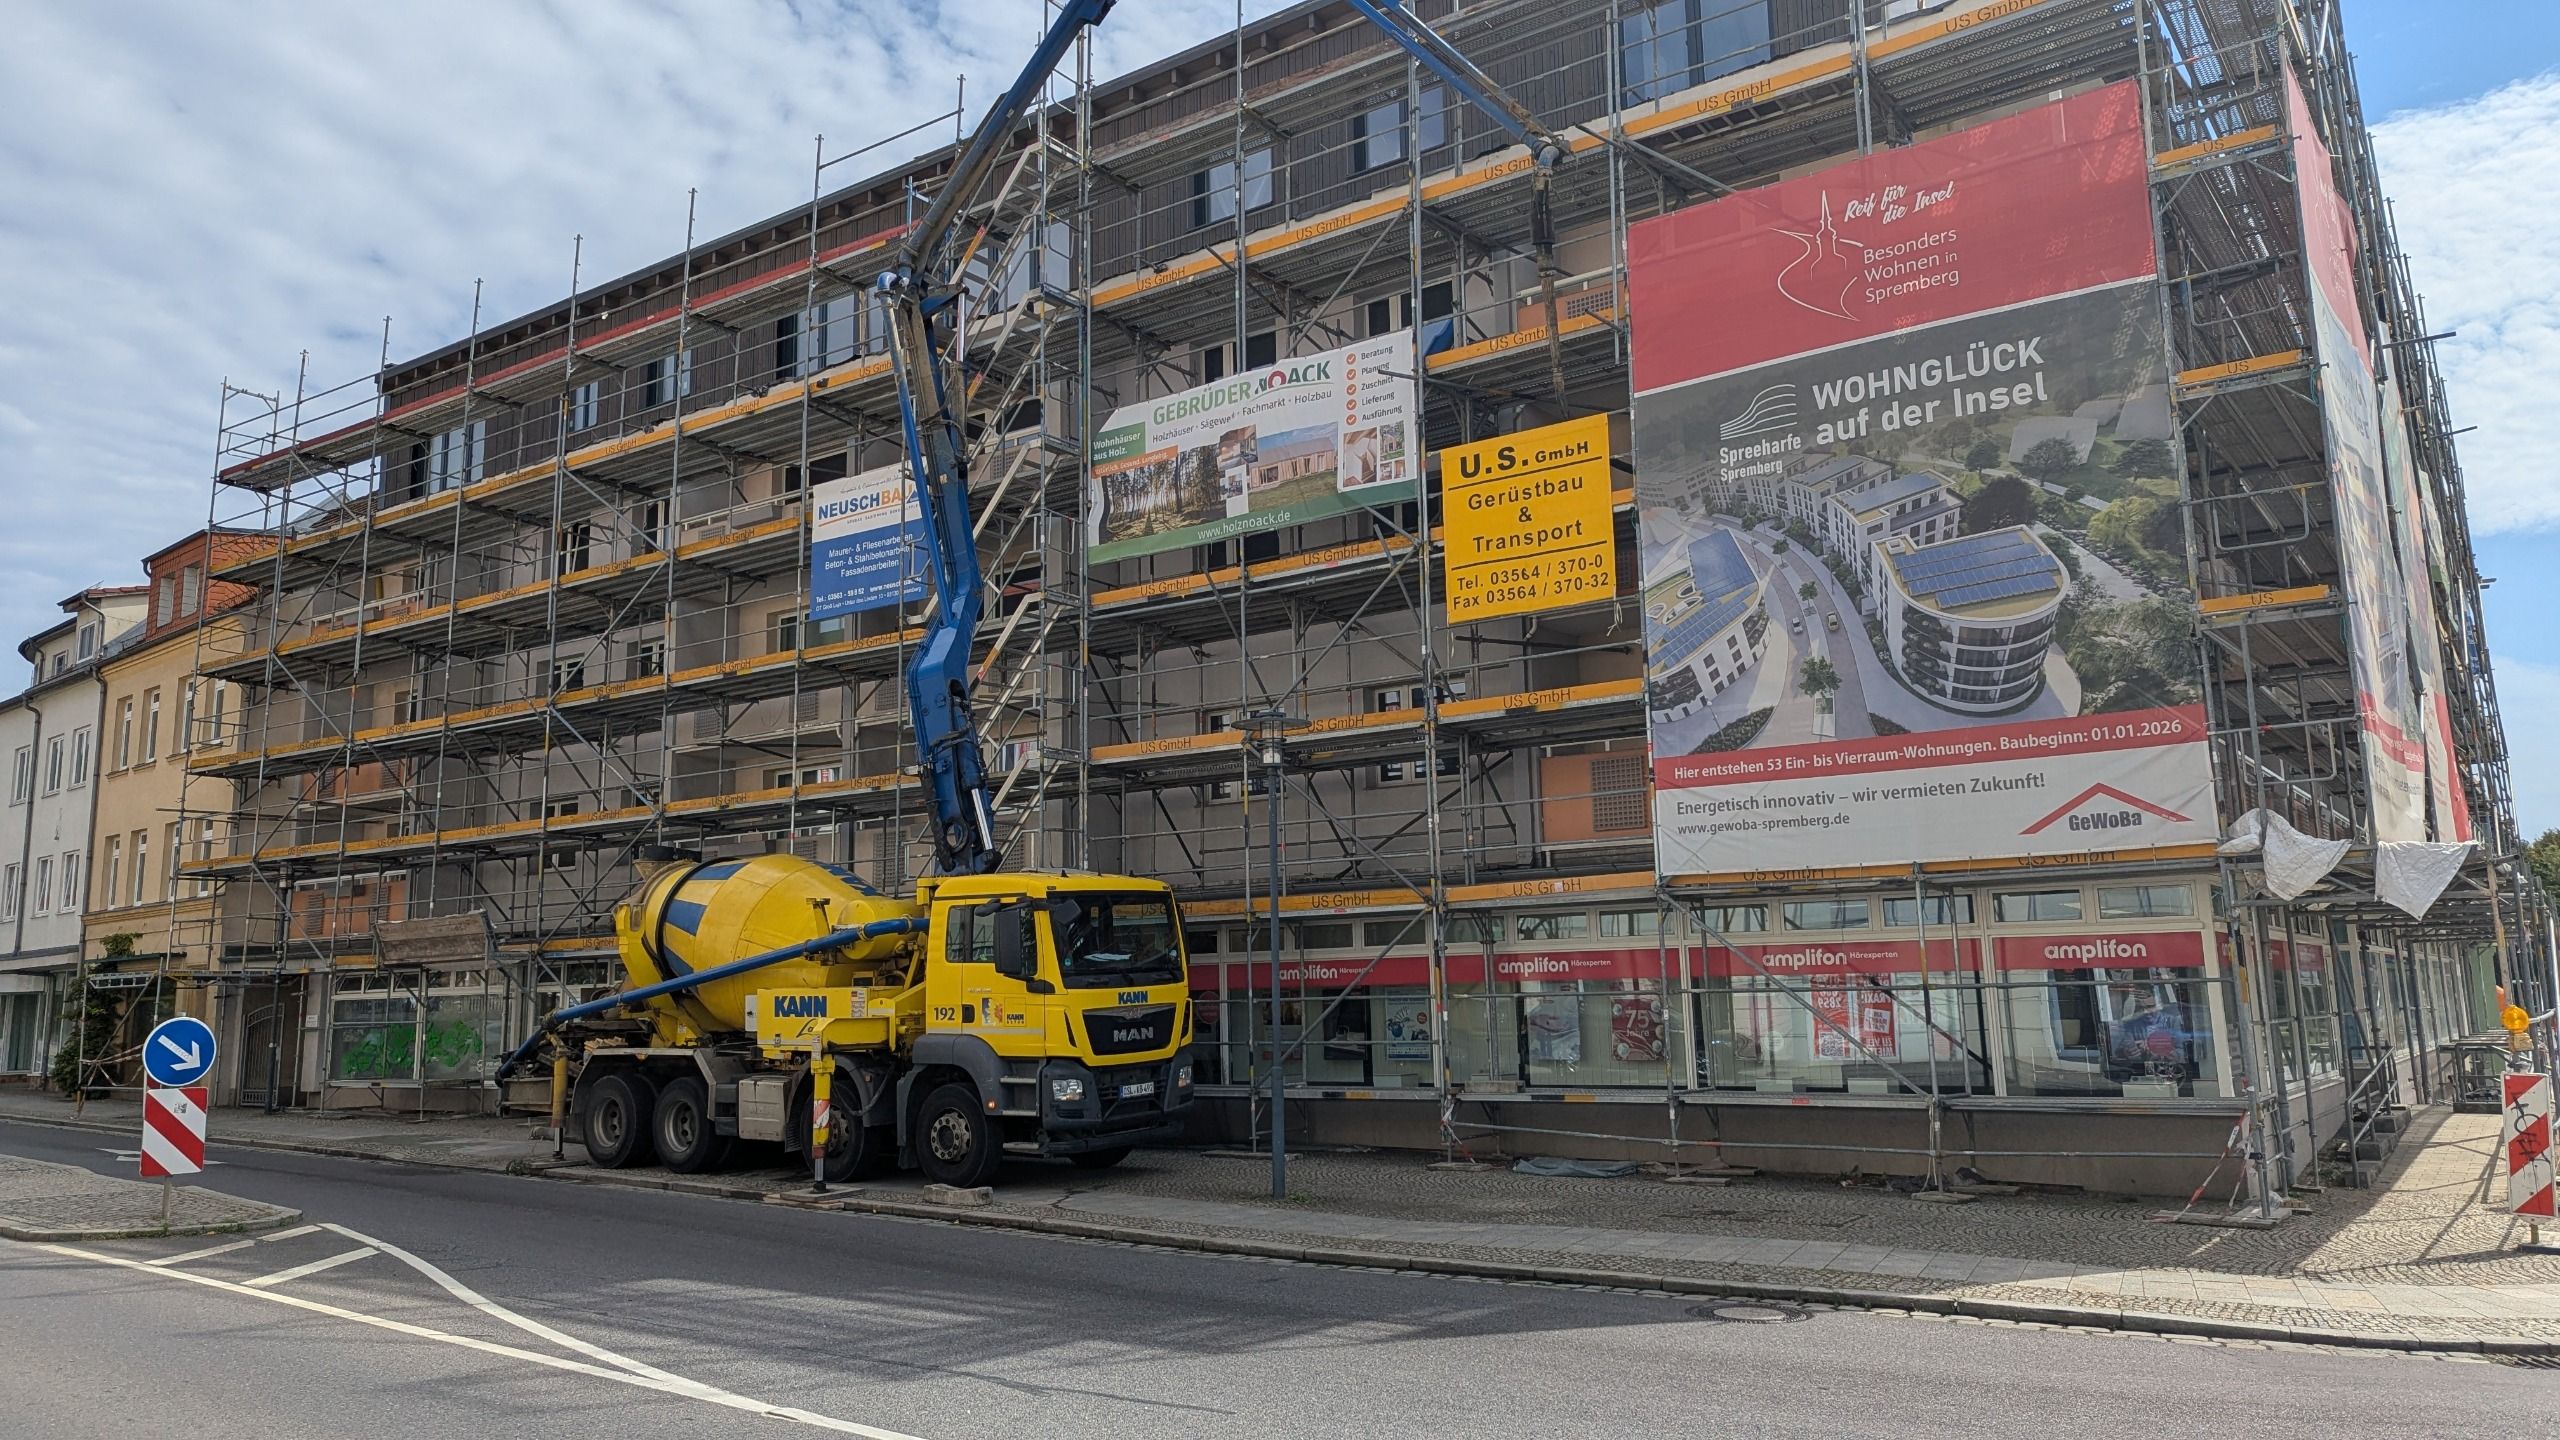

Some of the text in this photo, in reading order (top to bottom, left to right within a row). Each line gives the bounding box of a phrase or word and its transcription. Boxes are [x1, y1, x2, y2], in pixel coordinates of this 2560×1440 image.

[1945, 14, 1970, 32] US
[1696, 78, 1771, 113] US GmbH
[2203, 139, 2224, 153] US
[1484, 164, 1503, 180] US
[1844, 185, 1907, 222] Reif für
[1883, 181, 1954, 224] die Insel
[1296, 213, 1352, 240] US GmbH
[1864, 229, 1957, 264] Besonders
[1864, 252, 1958, 283] Wohnen in
[1136, 266, 1185, 290] US GmbH
[1865, 270, 1959, 304] Spremberg
[1489, 333, 1508, 351] US
[1361, 345, 1393, 360] Beratung
[872, 360, 892, 374] Gmb
[1361, 361, 1390, 375] Planung
[1812, 336, 2045, 410] WOHNGLÜCK
[2227, 360, 2249, 373] US
[1361, 376, 1394, 391] Zuschnitt
[1153, 381, 1252, 425] GEBRÜDER
[1361, 391, 1395, 406] Lieferung
[1816, 371, 2048, 445] auf der Insel
[724, 401, 759, 417] US GmbH
[1152, 390, 1332, 444] Holzhäuser Fachmarkt Holzbau
[1362, 405, 1402, 422] Ausführung
[1093, 431, 1142, 449] Wohnhäuser
[1719, 432, 1801, 464] Spreeharfe
[1093, 447, 1128, 461] aus Holz.
[1460, 441, 1589, 479] U.S. GmbH
[1720, 460, 1783, 483] Spremberg
[1468, 476, 1583, 510] Gerüstbau
[1518, 506, 1533, 523] &
[1197, 510, 1291, 540] www.holznoack.de
[720, 528, 754, 545] US GmbH
[1473, 520, 1583, 553] Transport
[828, 547, 854, 558] Maurer-
[855, 544, 861, 552] &
[1303, 545, 1360, 566] US GmbH
[825, 556, 853, 570] Beton- &
[840, 559, 899, 577] Fassadenarbeiten
[1457, 575, 1484, 591] Tel.
[1490, 565, 1540, 585] 03564
[1558, 554, 1603, 574] 370-0
[1140, 578, 1190, 596] US GmbH
[1453, 594, 1480, 610] Fax
[1486, 584, 1537, 604] 03564
[1554, 572, 1609, 594] 370-32
[2251, 592, 2274, 606] US
[852, 634, 892, 649] US GmbH
[593, 683, 626, 697] US GmbH
[1503, 688, 1571, 709] US GmbH
[1307, 715, 1364, 733] US GmbH
[1140, 738, 1191, 754] US GmbH
[1674, 719, 2182, 780] Hier entstehen 53 Ein- bis Vierraum-Wohnungen. Baubeginn: 01.01.2026
[850, 776, 891, 788] US GmbH
[1677, 796, 1760, 816] Energetisch
[1763, 791, 1835, 809] innovativ
[1852, 787, 1877, 803] wir
[1881, 780, 1966, 801] vermieten
[1971, 772, 2046, 793] Zukunft!
[1678, 812, 1850, 836] www.gewoba-spremberg.de
[2068, 811, 2142, 831] GeWoBa
[1512, 883, 1532, 897] US
[1311, 893, 1371, 908] US GmbH
[1762, 949, 1898, 970] amplifon Hörexperten
[2044, 939, 2147, 963] amplifon
[1499, 957, 1611, 977] amplifon Hörexperten
[774, 996, 827, 1017] KANN
[1118, 990, 1148, 1004] KANN
[933, 1007, 955, 1021] 192
[1625, 1009, 1649, 1029] 75
[1113, 1027, 1154, 1042] MAN
